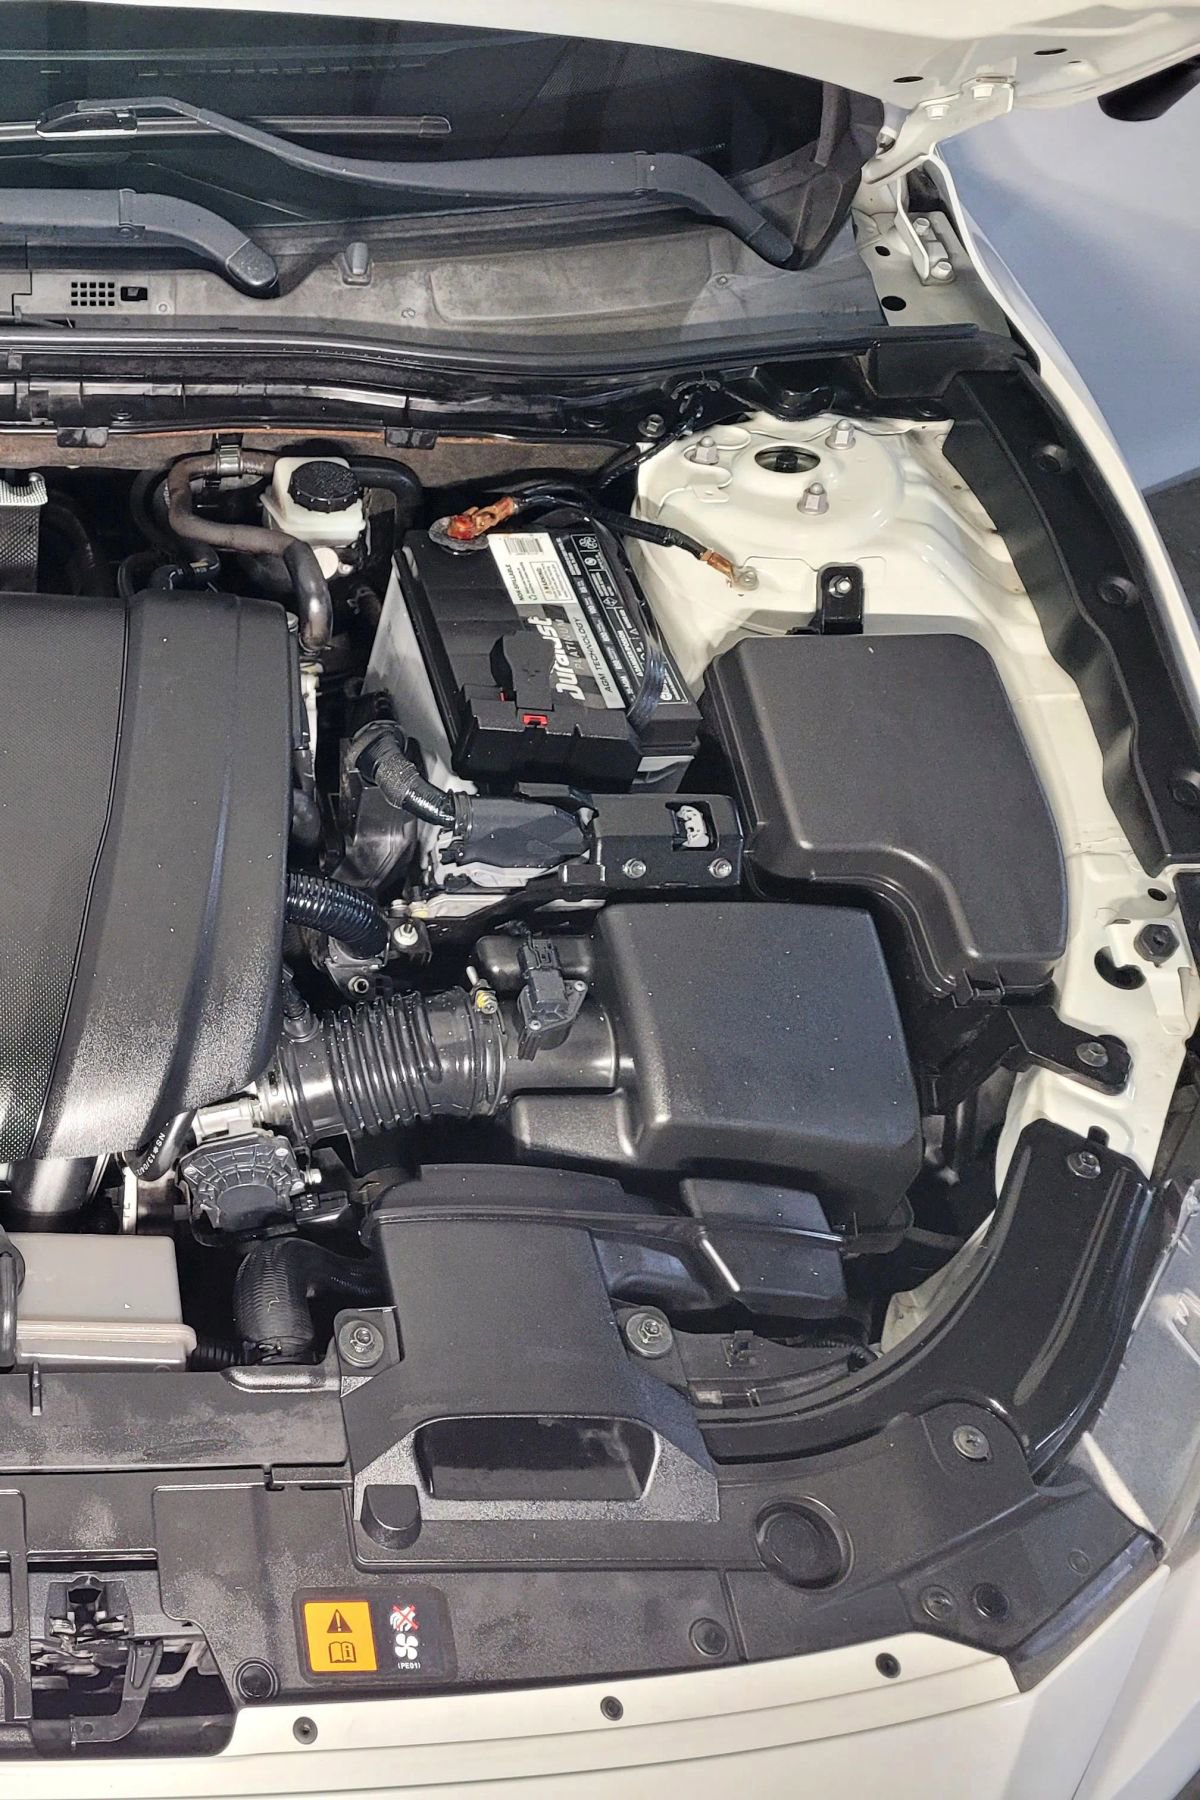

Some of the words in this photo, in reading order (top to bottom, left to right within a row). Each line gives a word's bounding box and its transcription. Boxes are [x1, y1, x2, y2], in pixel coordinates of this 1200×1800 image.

[555, 619, 585, 670] PLATINUM
[573, 616, 603, 671] TECHNOLOGY
[598, 673, 613, 693] AGM
